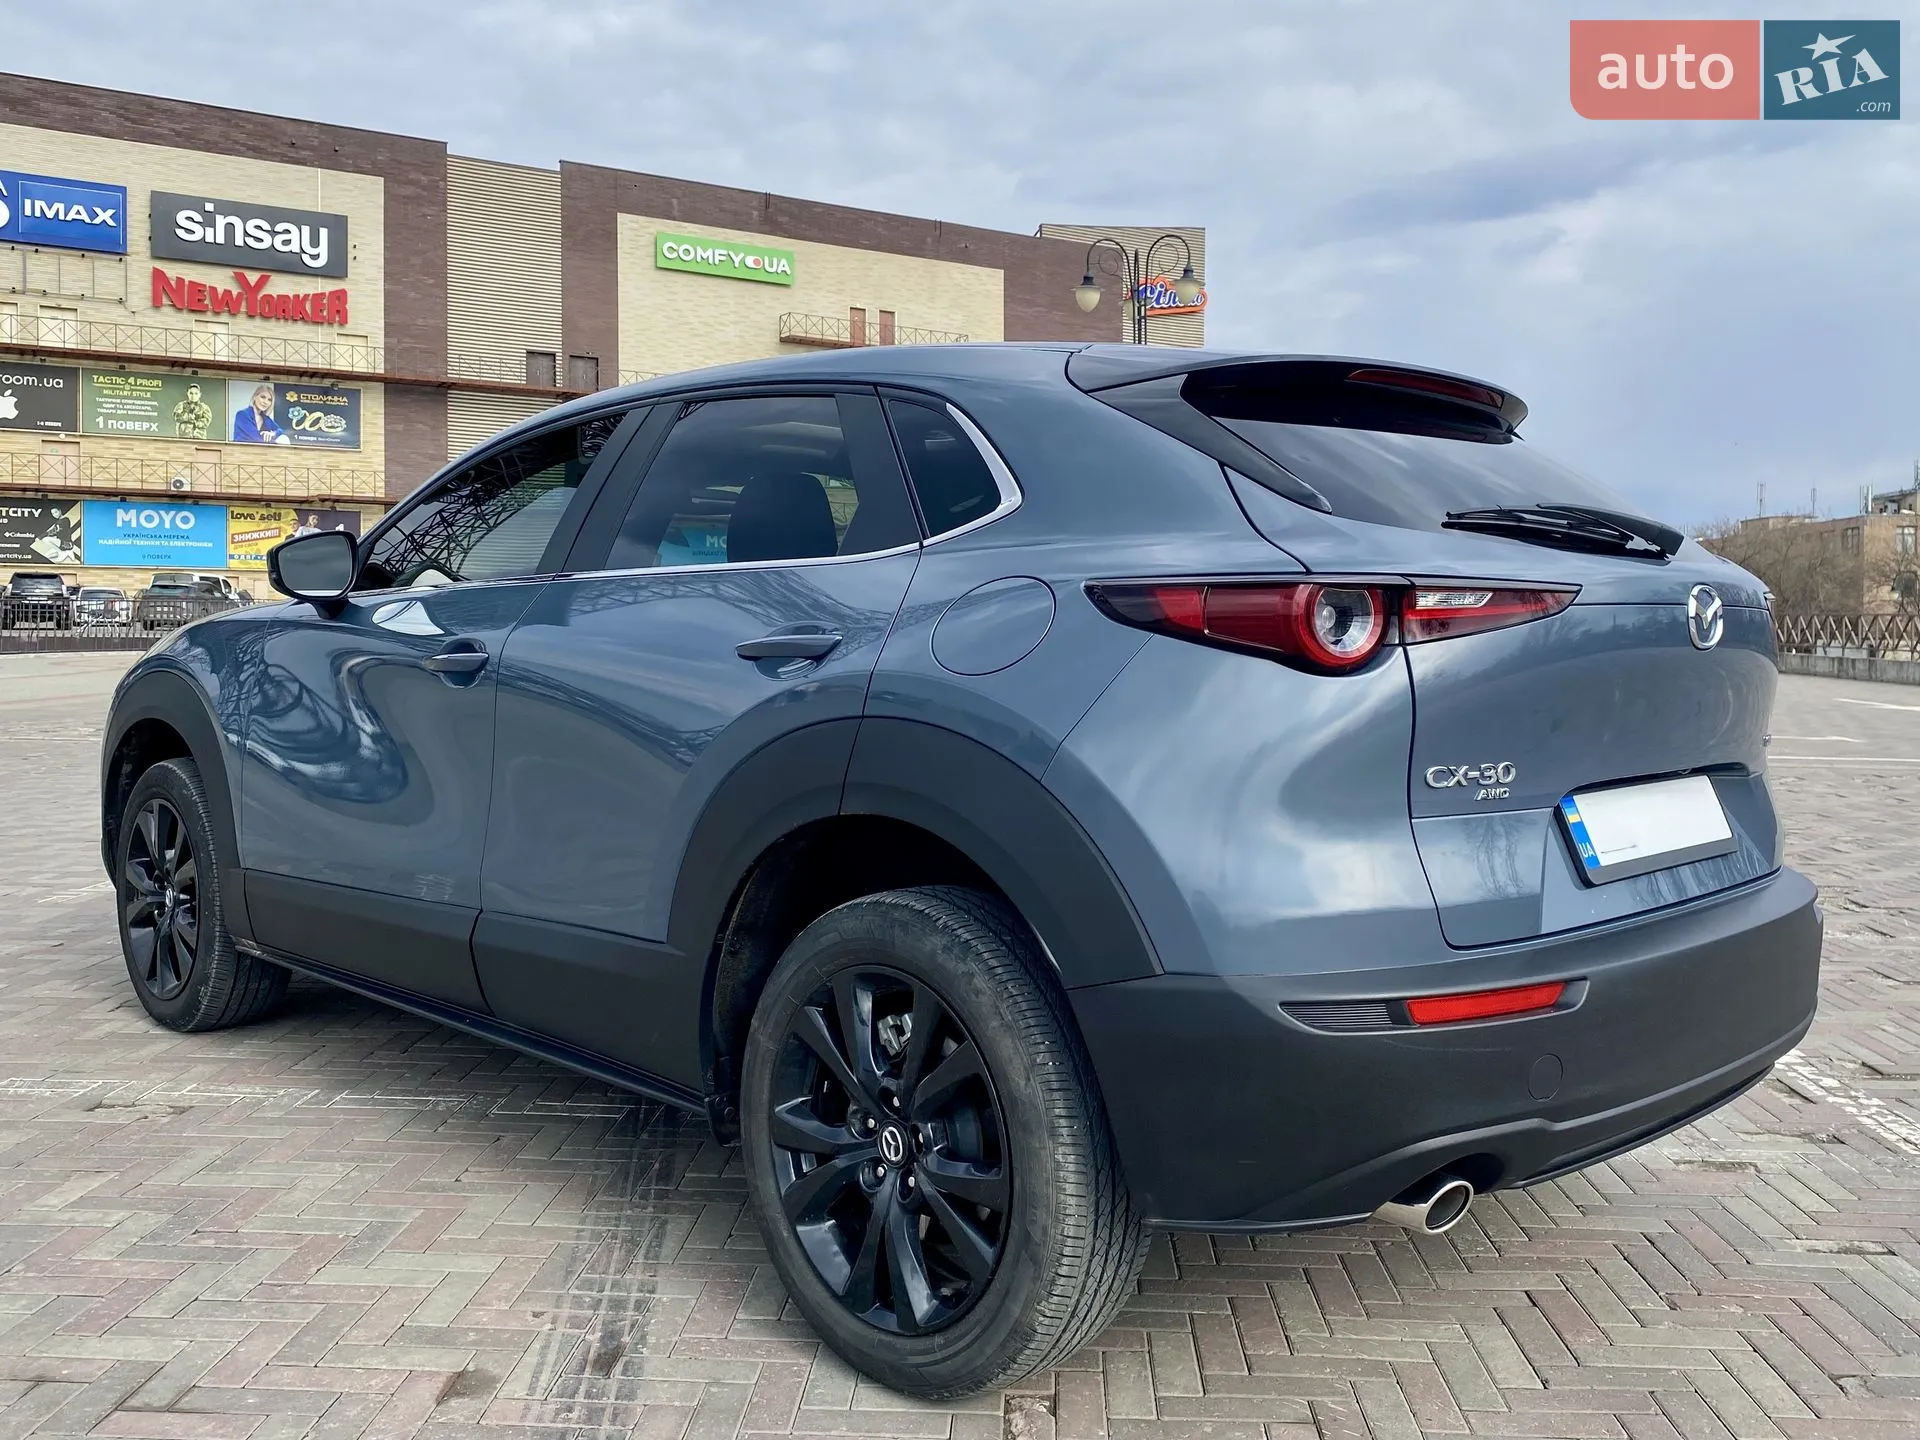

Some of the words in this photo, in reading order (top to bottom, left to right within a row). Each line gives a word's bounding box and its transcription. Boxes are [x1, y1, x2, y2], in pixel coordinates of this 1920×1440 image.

[23, 198, 117, 228] IMAX
[174, 201, 329, 268] sinsay
[0, 374, 64, 389] oom.ua
[92, 375, 126, 385] TACTIC
[127, 376, 135, 385] 4
[136, 378, 162, 387] PROFI
[103, 389, 132, 397] MILITARY
[95, 415, 104, 429] 1
[107, 419, 159, 432] ПОВЕРХ
[116, 508, 196, 530] MOYO
[123, 532, 163, 540] УКРАЇНСЬКА
[1424, 761, 1517, 789] CX-30
[1473, 787, 1511, 801] AWD
[1580, 842, 1596, 858] UA
